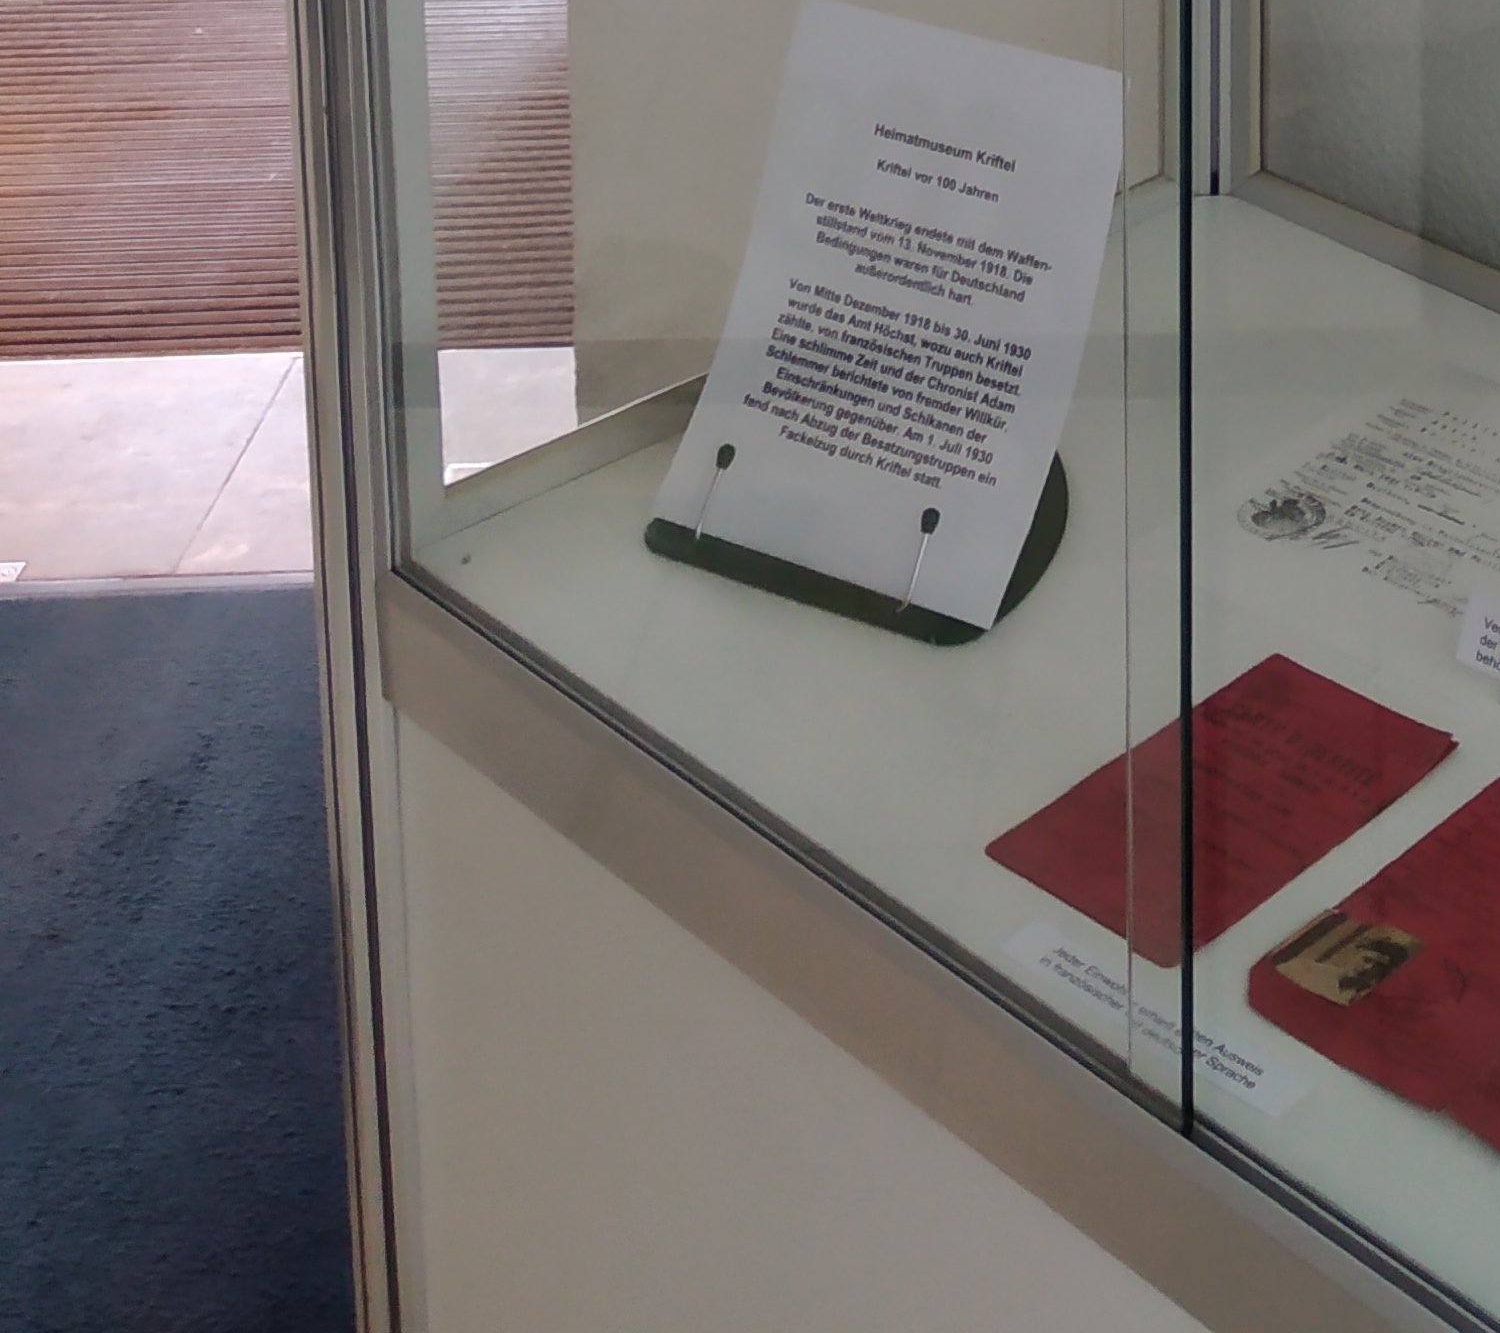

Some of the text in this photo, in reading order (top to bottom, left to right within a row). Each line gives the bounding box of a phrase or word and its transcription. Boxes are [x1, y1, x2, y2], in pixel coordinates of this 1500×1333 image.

[873, 122, 1016, 173] Heimatmuseum Kriftel
[876, 158, 999, 203] Kriftel vor 100 Jahren
[789, 277, 812, 294] Von
[813, 284, 842, 304] Mitte
[842, 293, 901, 321] Dezember
[904, 312, 932, 331] 1918
[932, 320, 951, 337] bis
[972, 333, 1002, 352] Juni
[1003, 341, 1032, 361] 1930
[1479, 634, 1499, 650] der
[1205, 1055, 1257, 1090] Sprache
